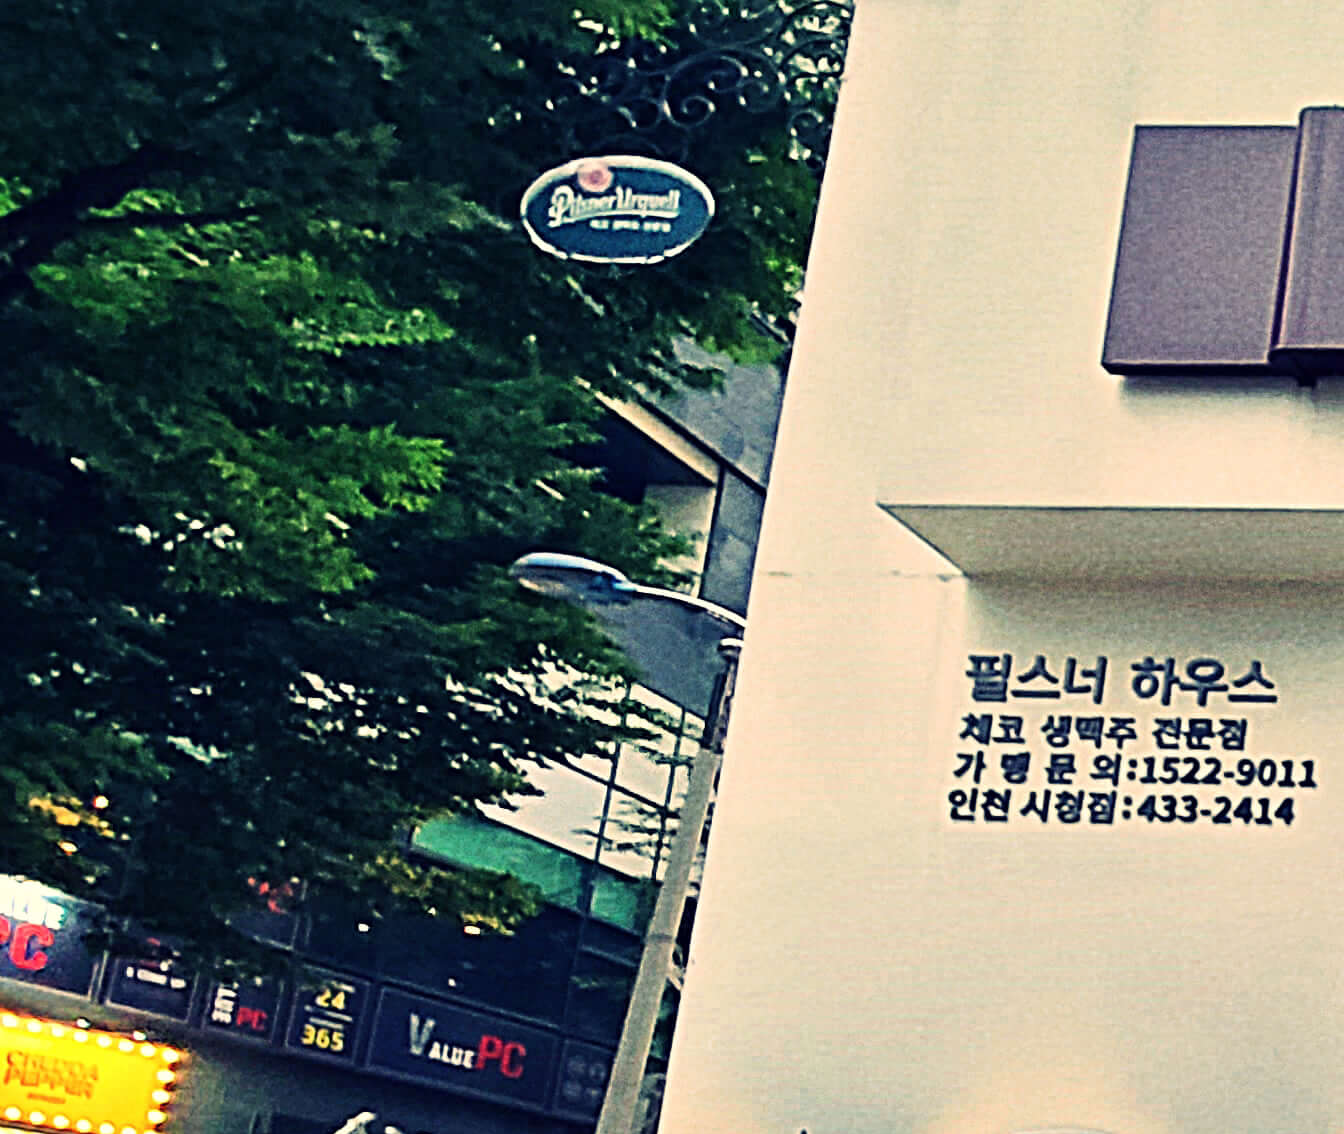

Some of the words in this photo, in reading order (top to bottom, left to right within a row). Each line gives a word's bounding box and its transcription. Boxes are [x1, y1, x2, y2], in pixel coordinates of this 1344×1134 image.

[547, 185, 616, 227] Pilsner
[615, 186, 680, 217] Urquell
[966, 654, 1108, 704] 필스너
[1131, 656, 1278, 706] 하우스
[959, 713, 1025, 744] 체코
[1040, 715, 1137, 748] 생맥주
[1152, 717, 1247, 751] 전문점
[948, 788, 1012, 822] 인천
[301, 1024, 344, 1051] 365
